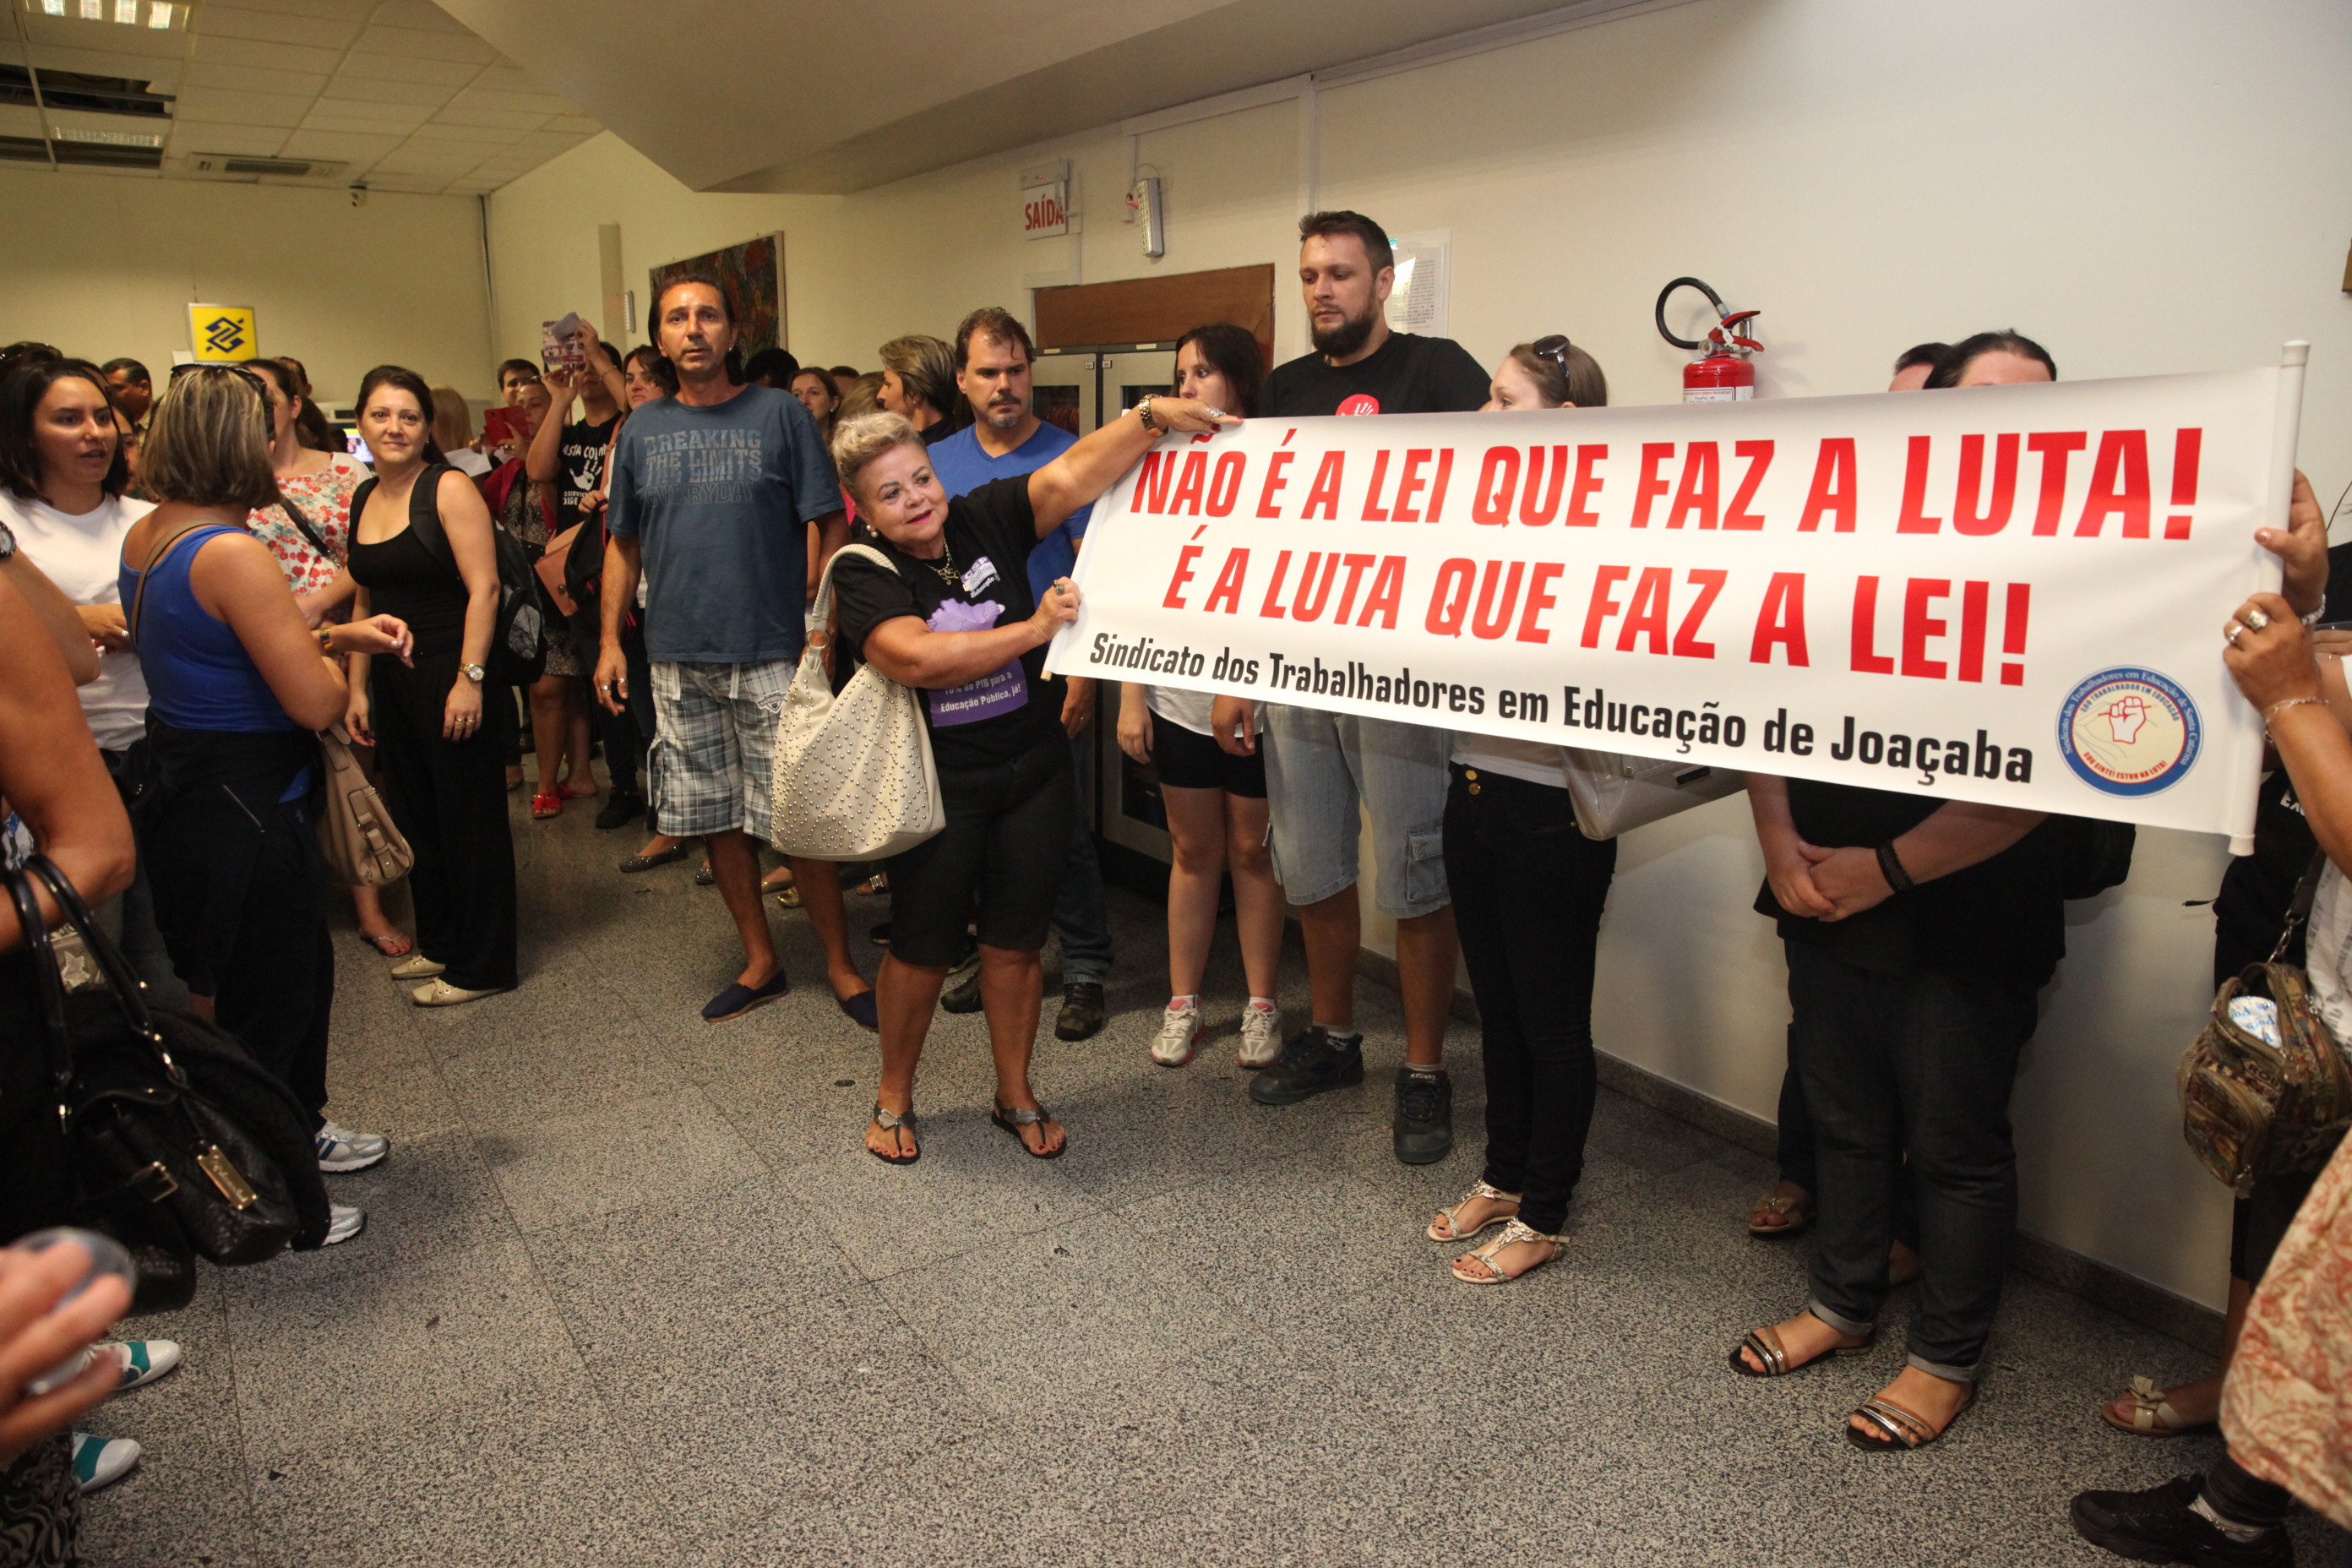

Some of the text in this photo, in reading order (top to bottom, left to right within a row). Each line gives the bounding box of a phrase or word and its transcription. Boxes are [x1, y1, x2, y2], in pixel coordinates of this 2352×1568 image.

[1025, 193, 1064, 231] SAÍDA
[643, 429, 761, 456] BREAKING
[645, 448, 762, 471] THE LIMITS
[1130, 427, 2203, 540] NÃO É A LEI QUE FAZ A LUTA!
[964, 558, 988, 580] CSP
[1162, 524, 2032, 687] É A LUTA QUE FAZ A LEI!
[975, 678, 989, 689] PIB
[990, 673, 1006, 688] para
[1006, 671, 1013, 679] a
[940, 698, 979, 713] Educação
[1090, 632, 2033, 785] Sindicato dos Trabalhadores em Educação de Joaçaba
